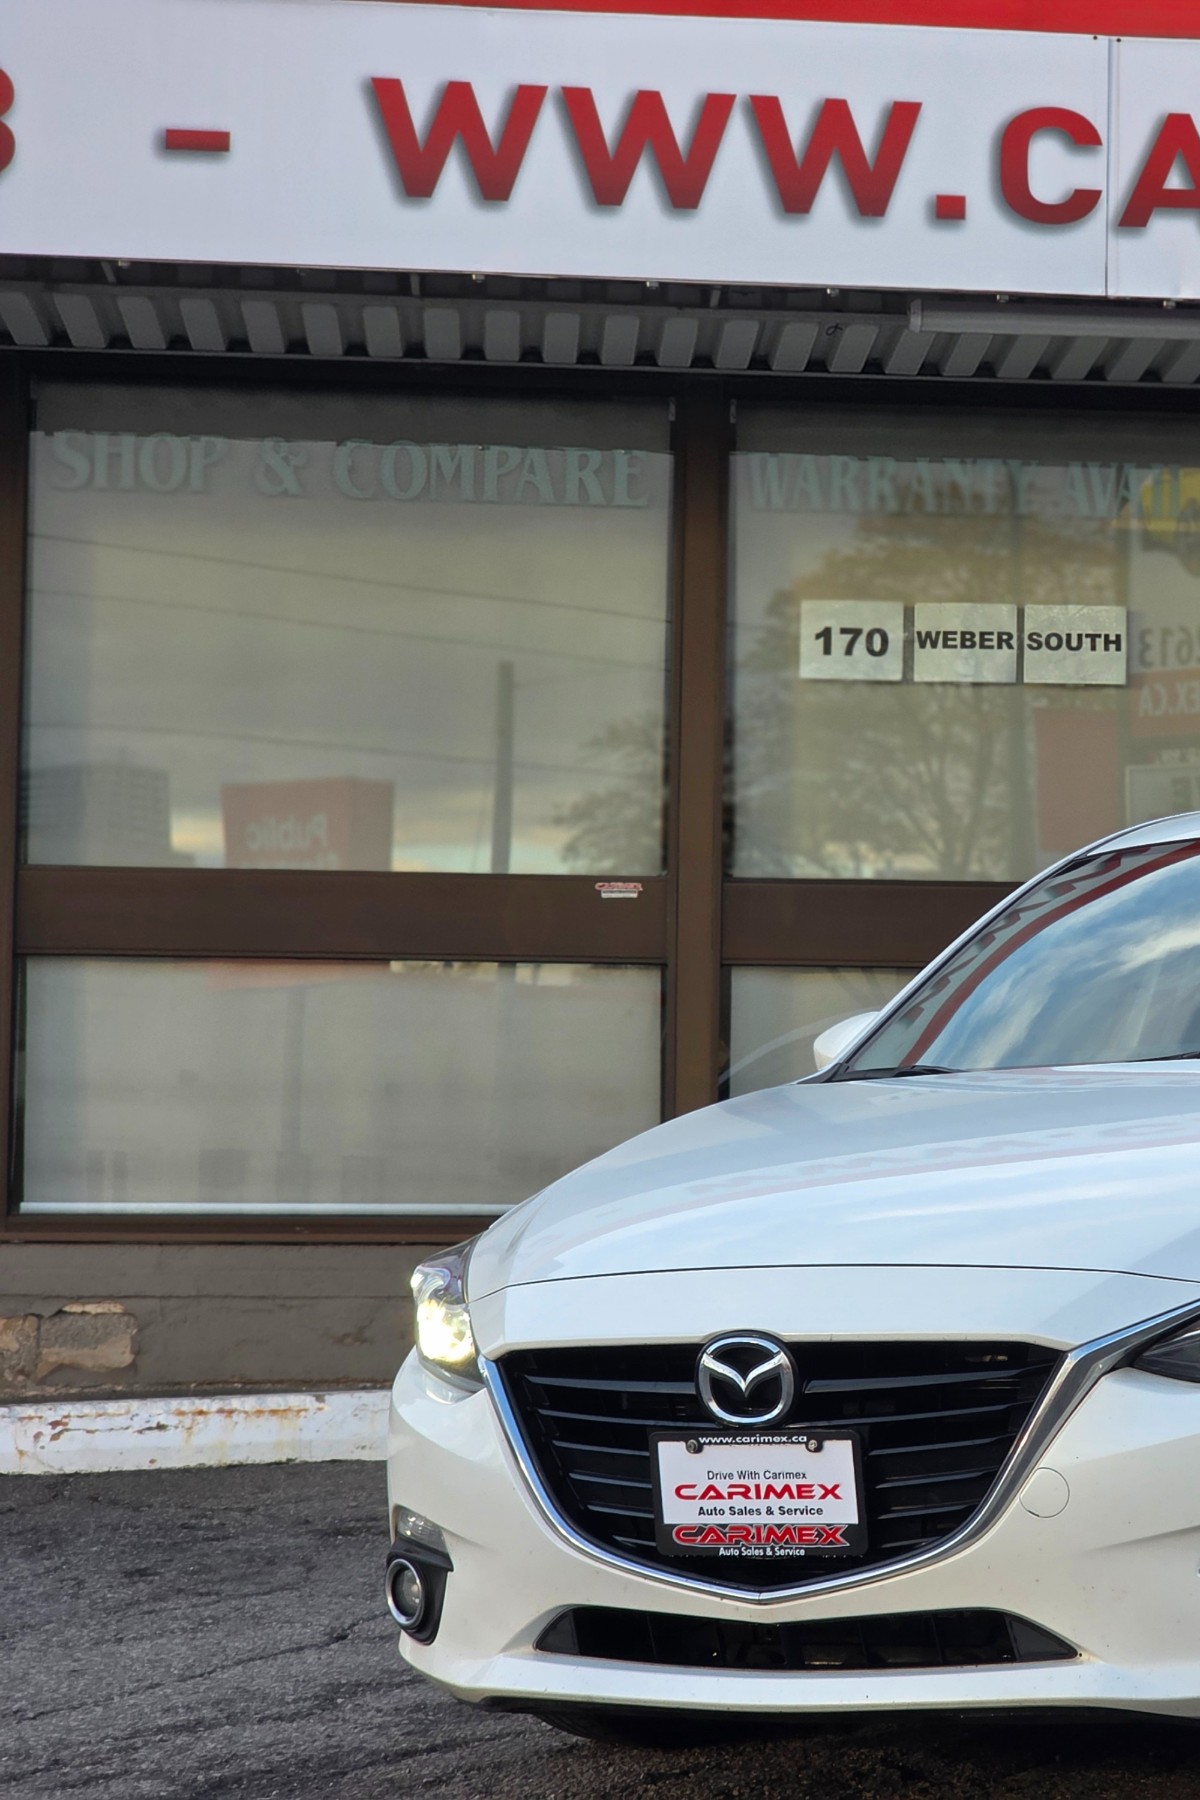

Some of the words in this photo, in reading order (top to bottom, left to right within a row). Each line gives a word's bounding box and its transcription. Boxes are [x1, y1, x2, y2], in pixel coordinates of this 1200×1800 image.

[52, 429, 227, 493] SHOP
[257, 436, 309, 496] &
[334, 438, 649, 507] COMPARE
[747, 453, 1040, 515] WARRANTY
[814, 627, 890, 657] 170
[916, 630, 1014, 651] WEBER
[1026, 631, 1122, 653] SOUTH
[699, 1434, 807, 1443] www.carimex.ca
[707, 1470, 734, 1480] Drive
[737, 1470, 760, 1480] With
[763, 1470, 807, 1480] Carimex
[674, 1484, 843, 1500] CARIMEX
[698, 1506, 725, 1516] Auto
[729, 1506, 762, 1516] Sales
[765, 1506, 775, 1516] &
[778, 1506, 824, 1516] Service
[674, 1524, 849, 1546] CARIMEX
[719, 1546, 738, 1556] Auto
[741, 1547, 764, 1556] Sales
[766, 1547, 773, 1556] &
[774, 1546, 806, 1556] Service
